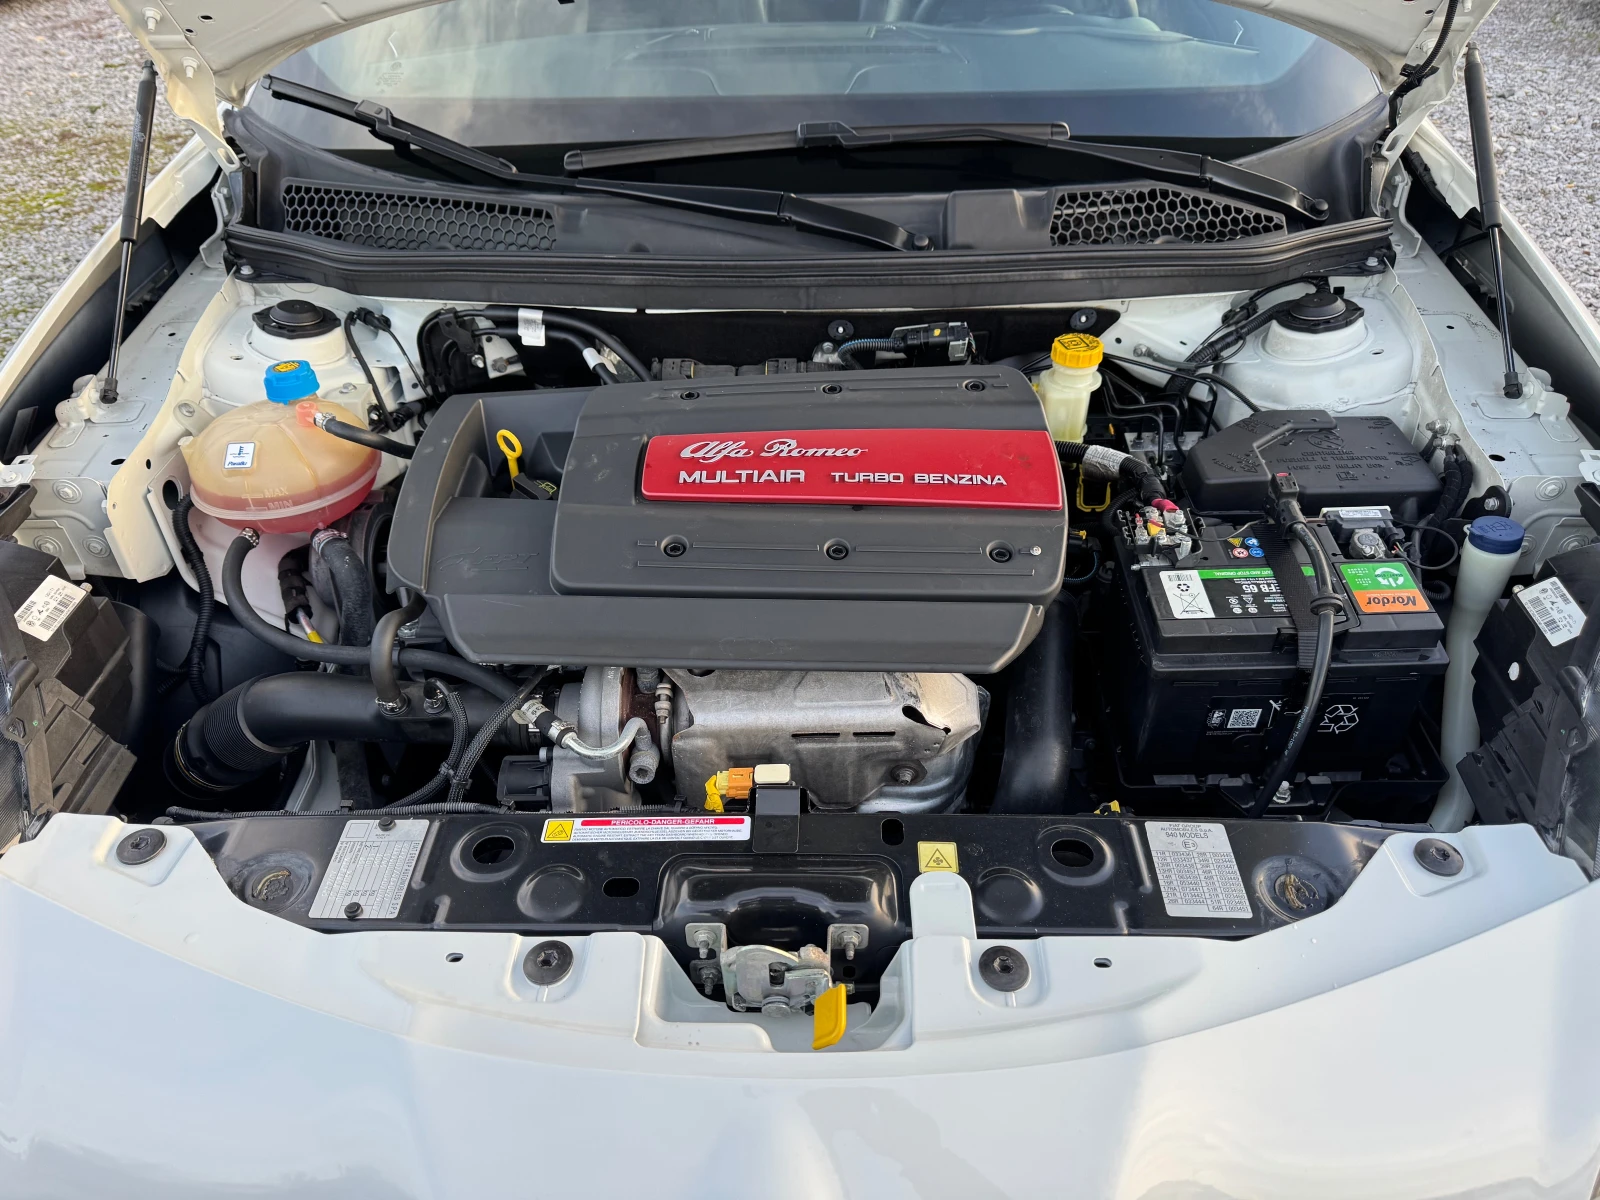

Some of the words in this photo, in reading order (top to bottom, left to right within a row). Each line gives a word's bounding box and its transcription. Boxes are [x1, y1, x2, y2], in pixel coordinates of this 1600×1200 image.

[680, 440, 754, 462] Alfa
[760, 438, 868, 459] Romeo
[679, 469, 805, 484] MULTIAIR
[831, 472, 904, 483] TURBO
[914, 473, 1007, 486] BENZINA
[264, 486, 288, 498] MAX
[268, 500, 293, 510] MIN
[1242, 584, 1258, 593] 65
[1367, 596, 1416, 606] Nordor
[393, 868, 410, 900] AUTOMOBILES
